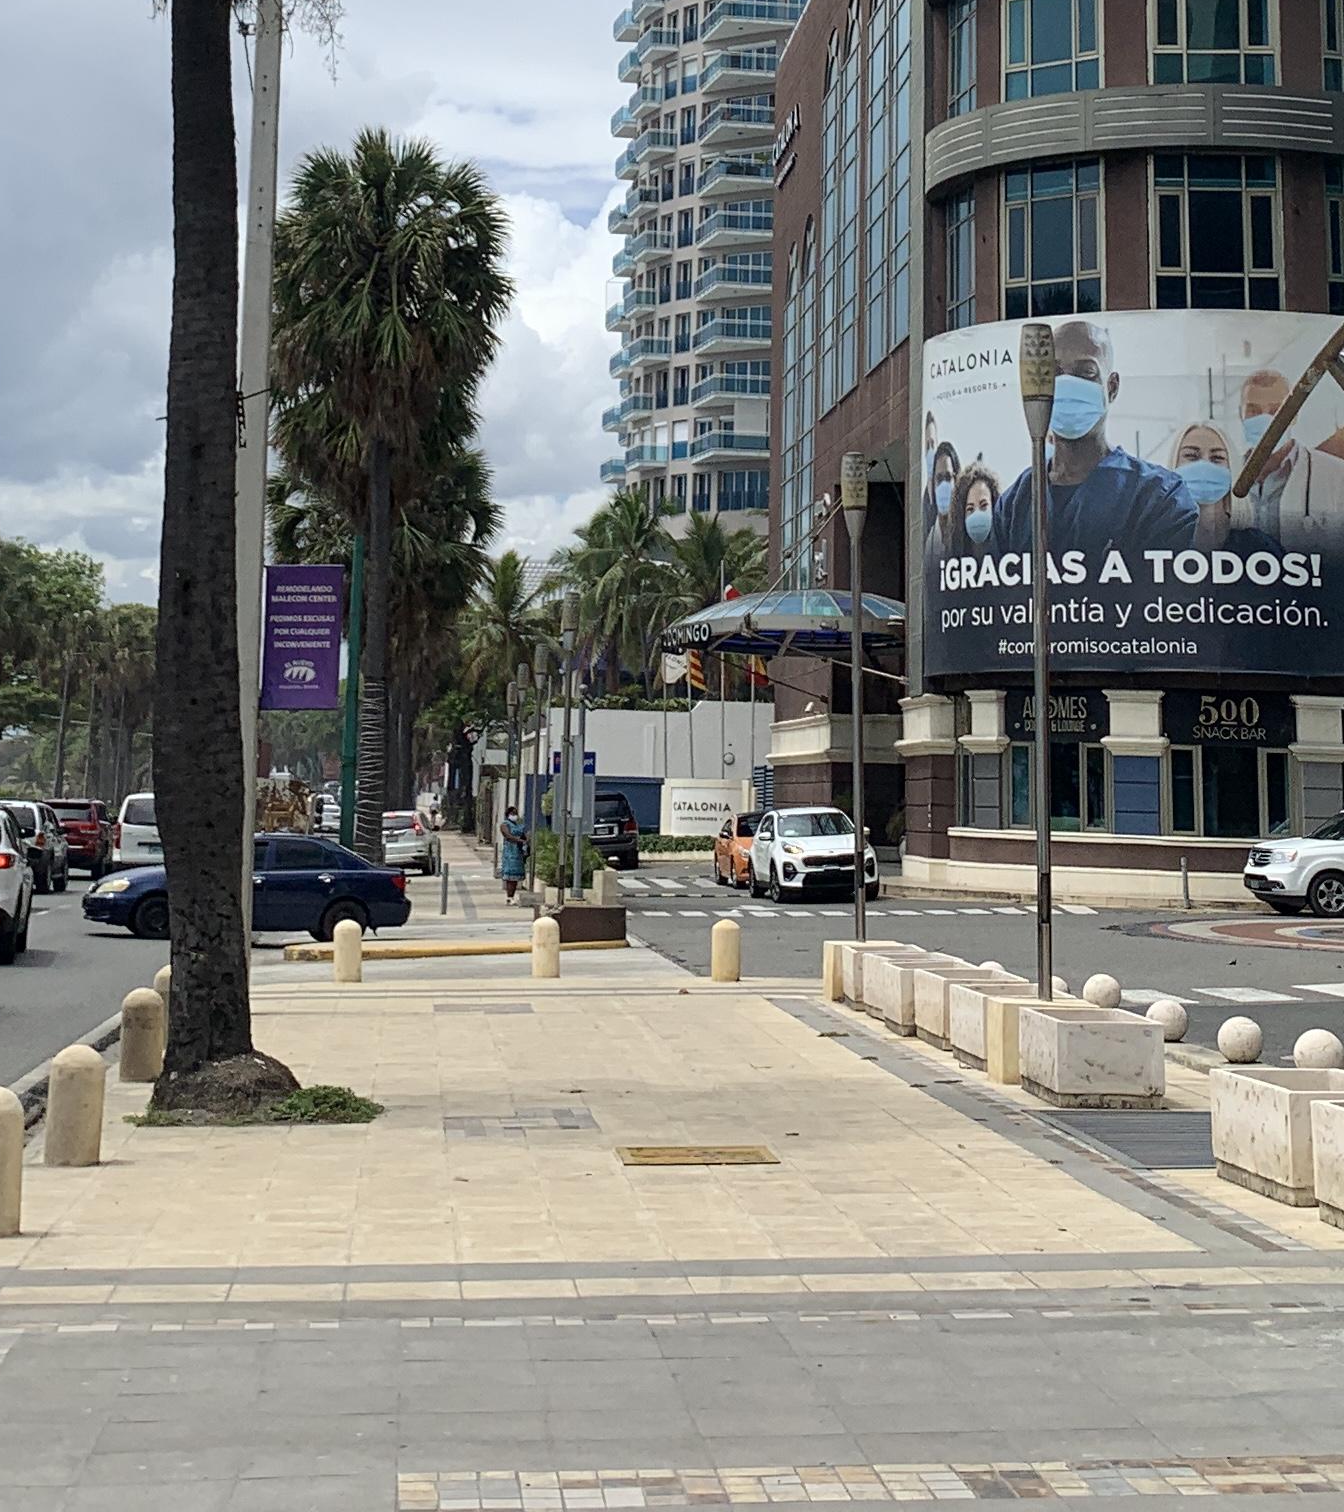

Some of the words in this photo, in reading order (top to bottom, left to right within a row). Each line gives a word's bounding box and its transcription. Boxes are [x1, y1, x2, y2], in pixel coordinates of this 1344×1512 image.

[930, 349, 1013, 379] CATALONIA
[1098, 550, 1133, 584] A
[1144, 549, 1323, 587] TODOS!
[308, 595, 338, 603] CENTER
[941, 607, 966, 633] por
[971, 605, 994, 626] su
[1000, 595, 1105, 624] valntía
[1115, 601, 1134, 628] y
[1144, 596, 1329, 628] dedicación.
[997, 637, 1198, 656] #comromisocatalonia
[1022, 696, 1087, 719] AOMES
[1198, 695, 1260, 727] 500
[1192, 726, 1238, 739] SNACK
[1240, 727, 1266, 740] BAR
[673, 801, 731, 811] CATALONIA
